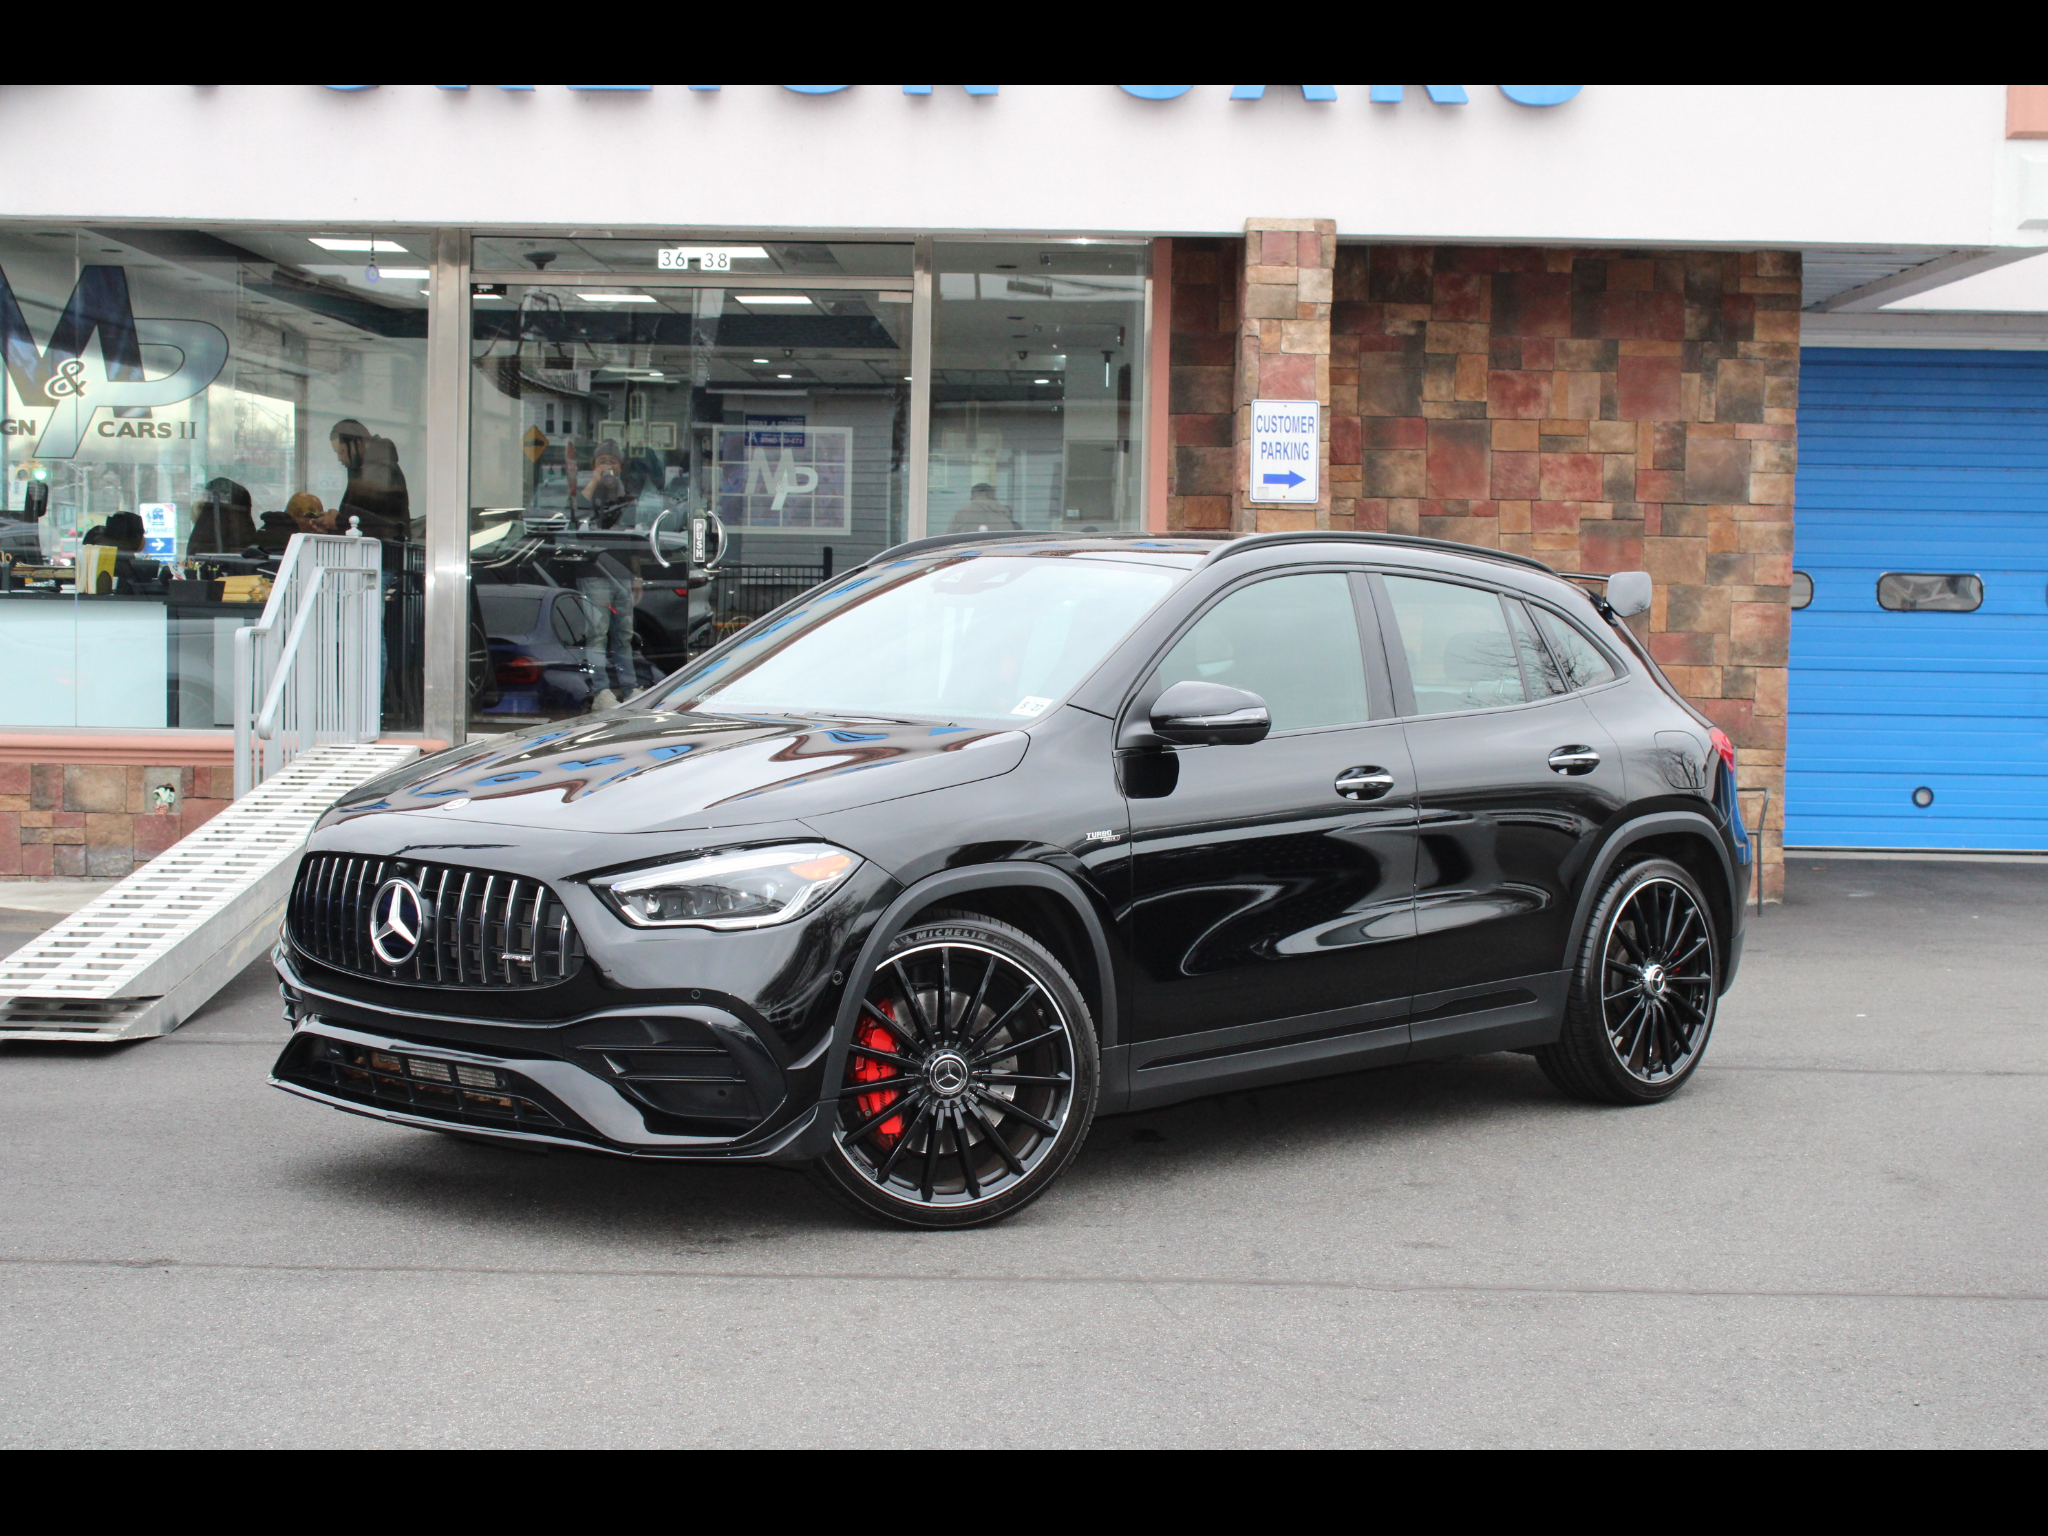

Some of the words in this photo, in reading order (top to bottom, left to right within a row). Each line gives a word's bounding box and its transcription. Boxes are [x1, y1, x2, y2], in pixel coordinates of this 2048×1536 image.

[97, 421, 172, 438] CARS
[178, 421, 198, 440] II
[1256, 415, 1315, 434] CUSTOMER
[1261, 441, 1309, 461] PARKING
[695, 522, 703, 558] PUSH
[1086, 829, 1112, 839] TURBO
[916, 928, 988, 940] MICHELIN
[993, 938, 1012, 949] PILOT
